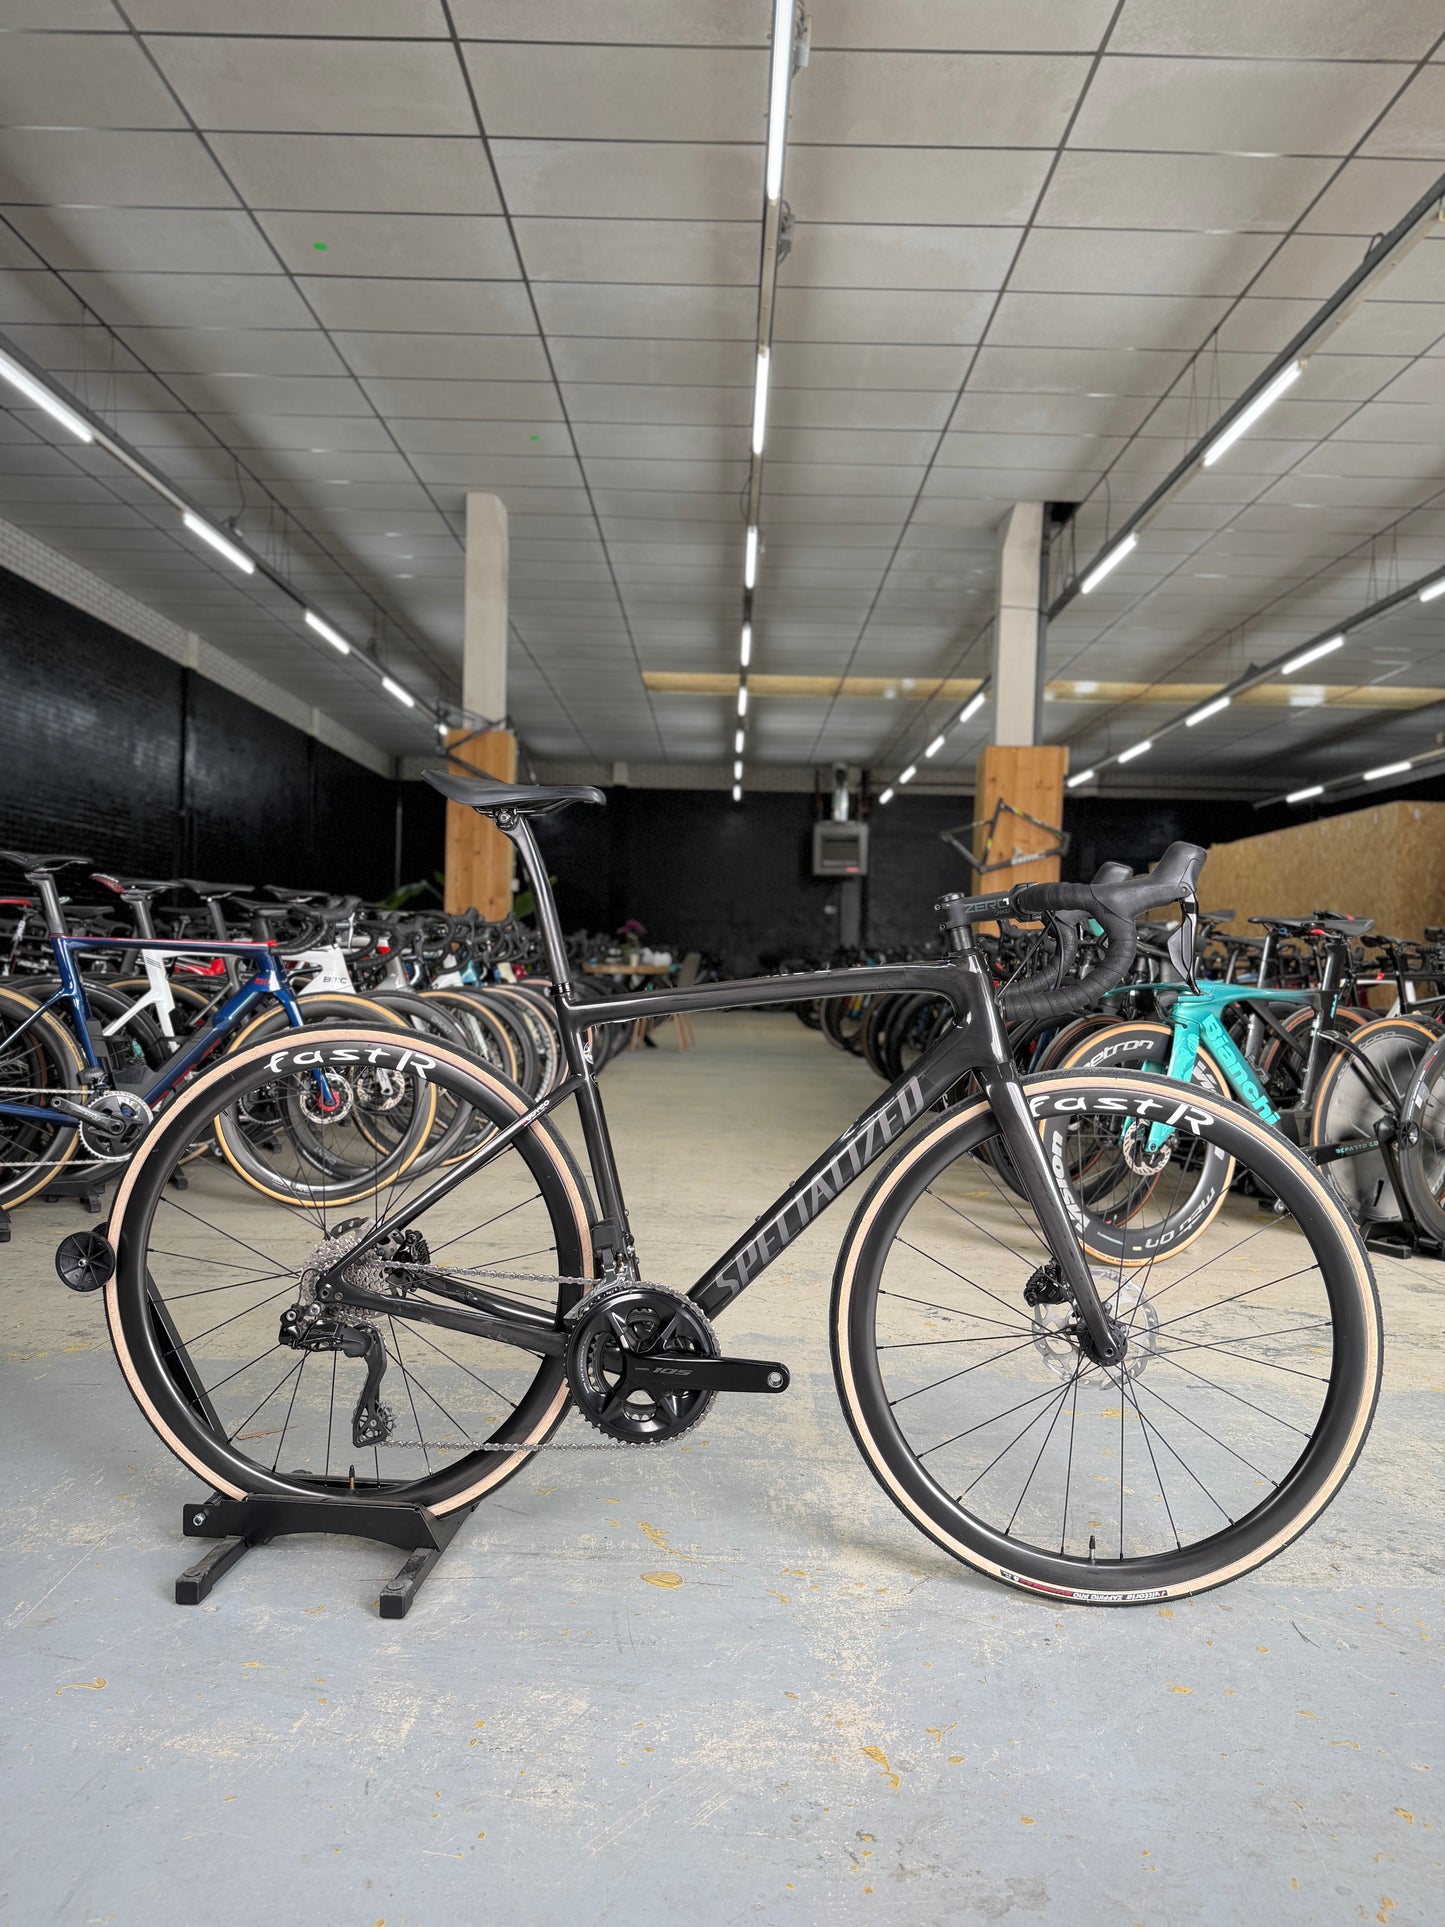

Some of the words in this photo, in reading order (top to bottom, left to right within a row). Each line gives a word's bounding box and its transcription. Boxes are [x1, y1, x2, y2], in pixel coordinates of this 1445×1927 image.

[1083, 1039, 1154, 1067] etron
[1202, 1014, 1281, 1125] Bianchi
[716, 1076, 925, 1296] SPECIALIZED
[652, 1367, 694, 1376] 105
